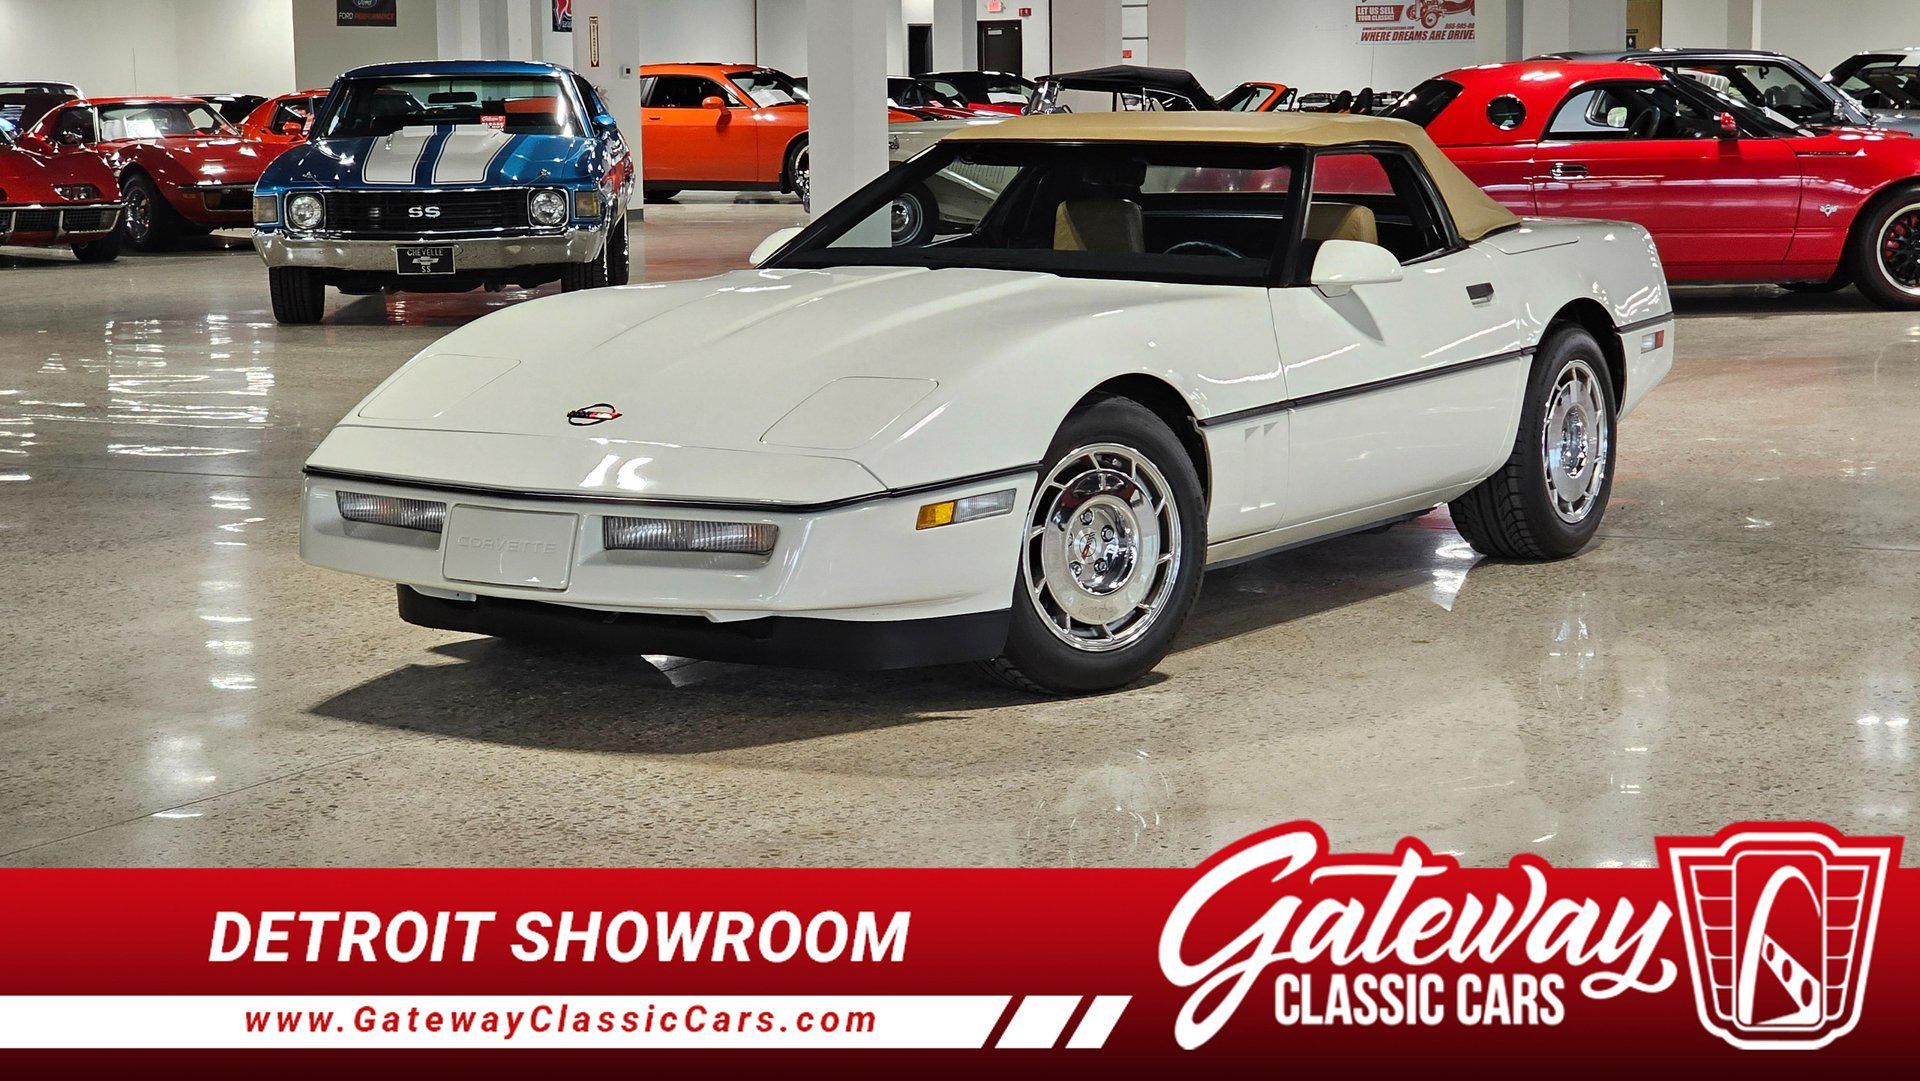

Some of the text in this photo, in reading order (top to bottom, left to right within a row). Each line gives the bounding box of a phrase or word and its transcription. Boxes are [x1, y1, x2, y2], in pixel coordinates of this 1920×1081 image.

[1357, 6, 1394, 15] LET US SELL
[338, 12, 354, 20] FORD
[1361, 29, 1475, 41] WHERE DREAMS ARE DRIVE
[408, 206, 441, 218] SS
[406, 248, 443, 256] CHEVELLE
[421, 265, 432, 273] SS
[457, 535, 557, 553] CORVETTE
